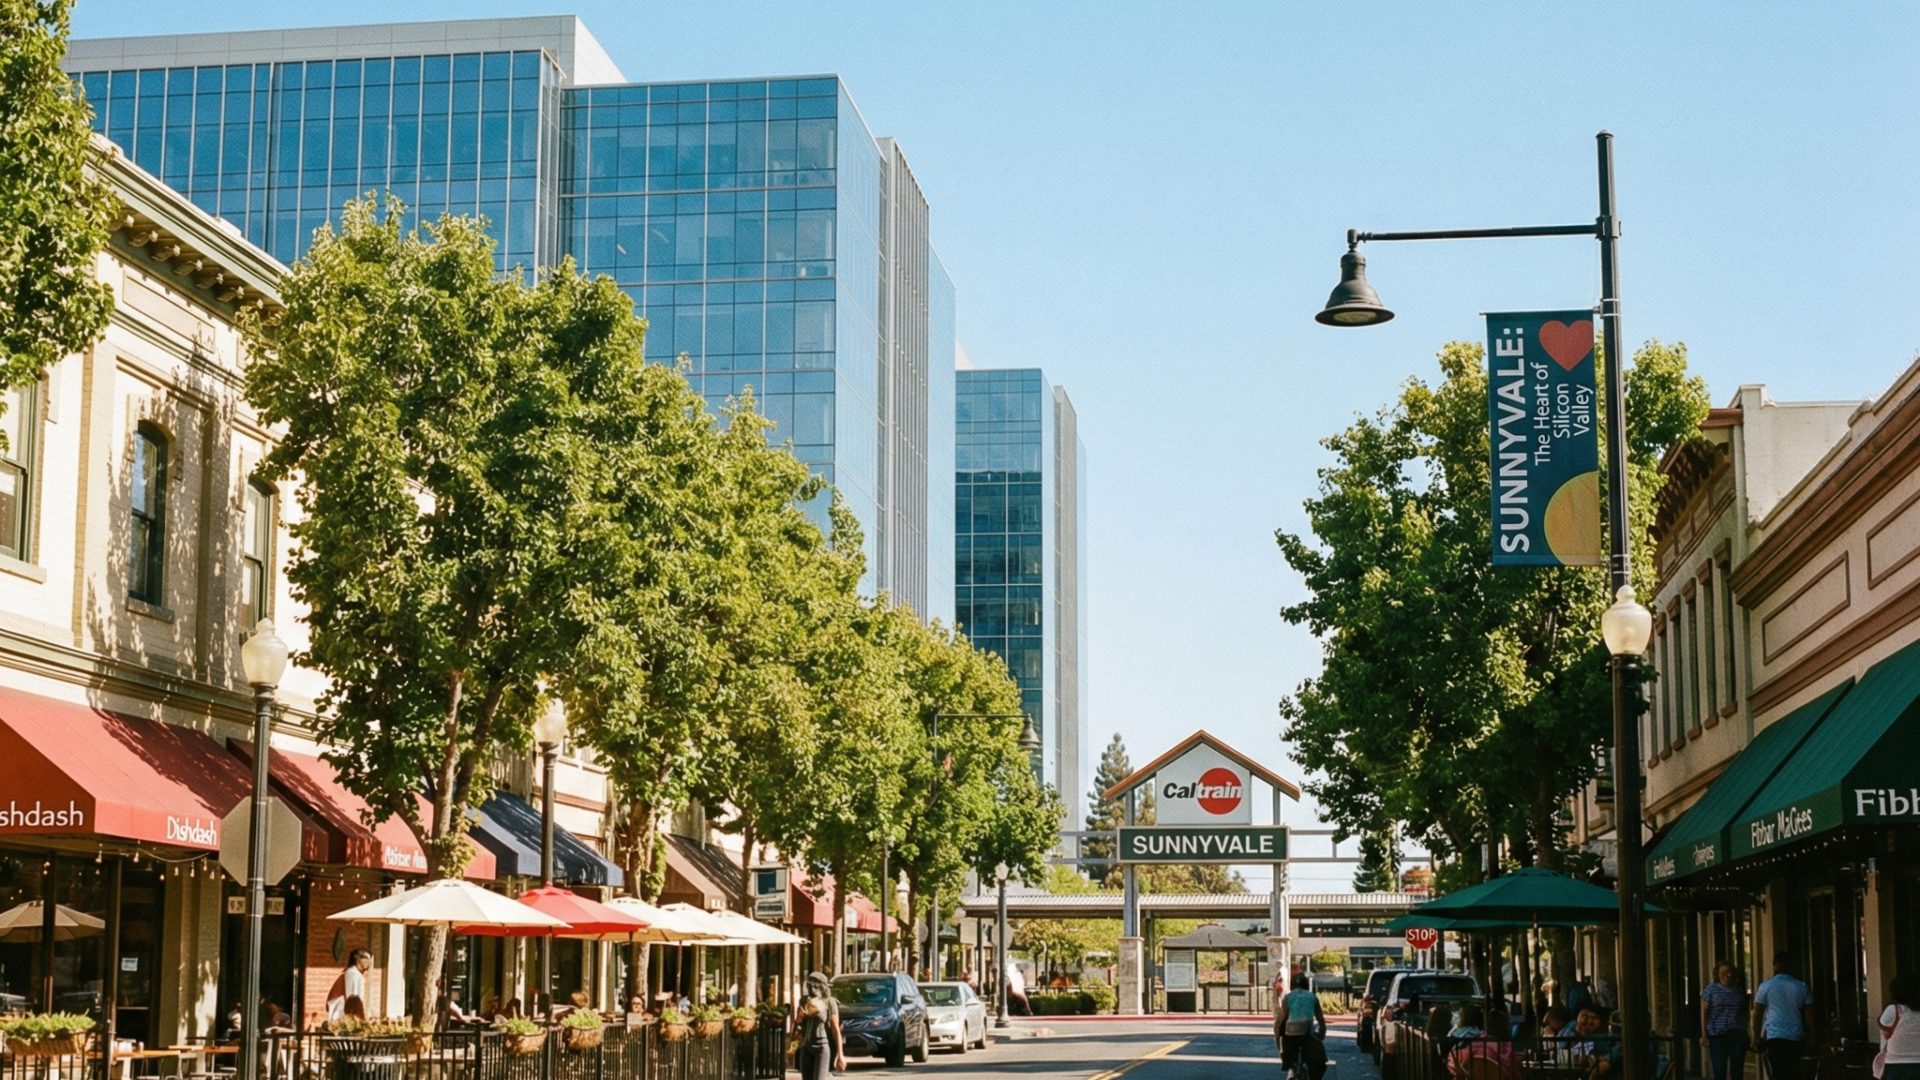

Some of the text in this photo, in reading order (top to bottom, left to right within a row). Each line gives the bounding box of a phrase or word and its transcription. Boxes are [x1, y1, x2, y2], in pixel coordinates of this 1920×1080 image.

[1530, 362, 1550, 466] The Heart of
[1552, 383, 1571, 438] Silicon
[1571, 383, 1594, 436] Valley
[1496, 327, 1530, 553] SUNNYVALE:
[1163, 781, 1242, 799] Caltrain
[167, 815, 217, 846] Dishdash
[1132, 834, 1274, 854] SUNNYVALE
[1408, 928, 1435, 941] STOP
